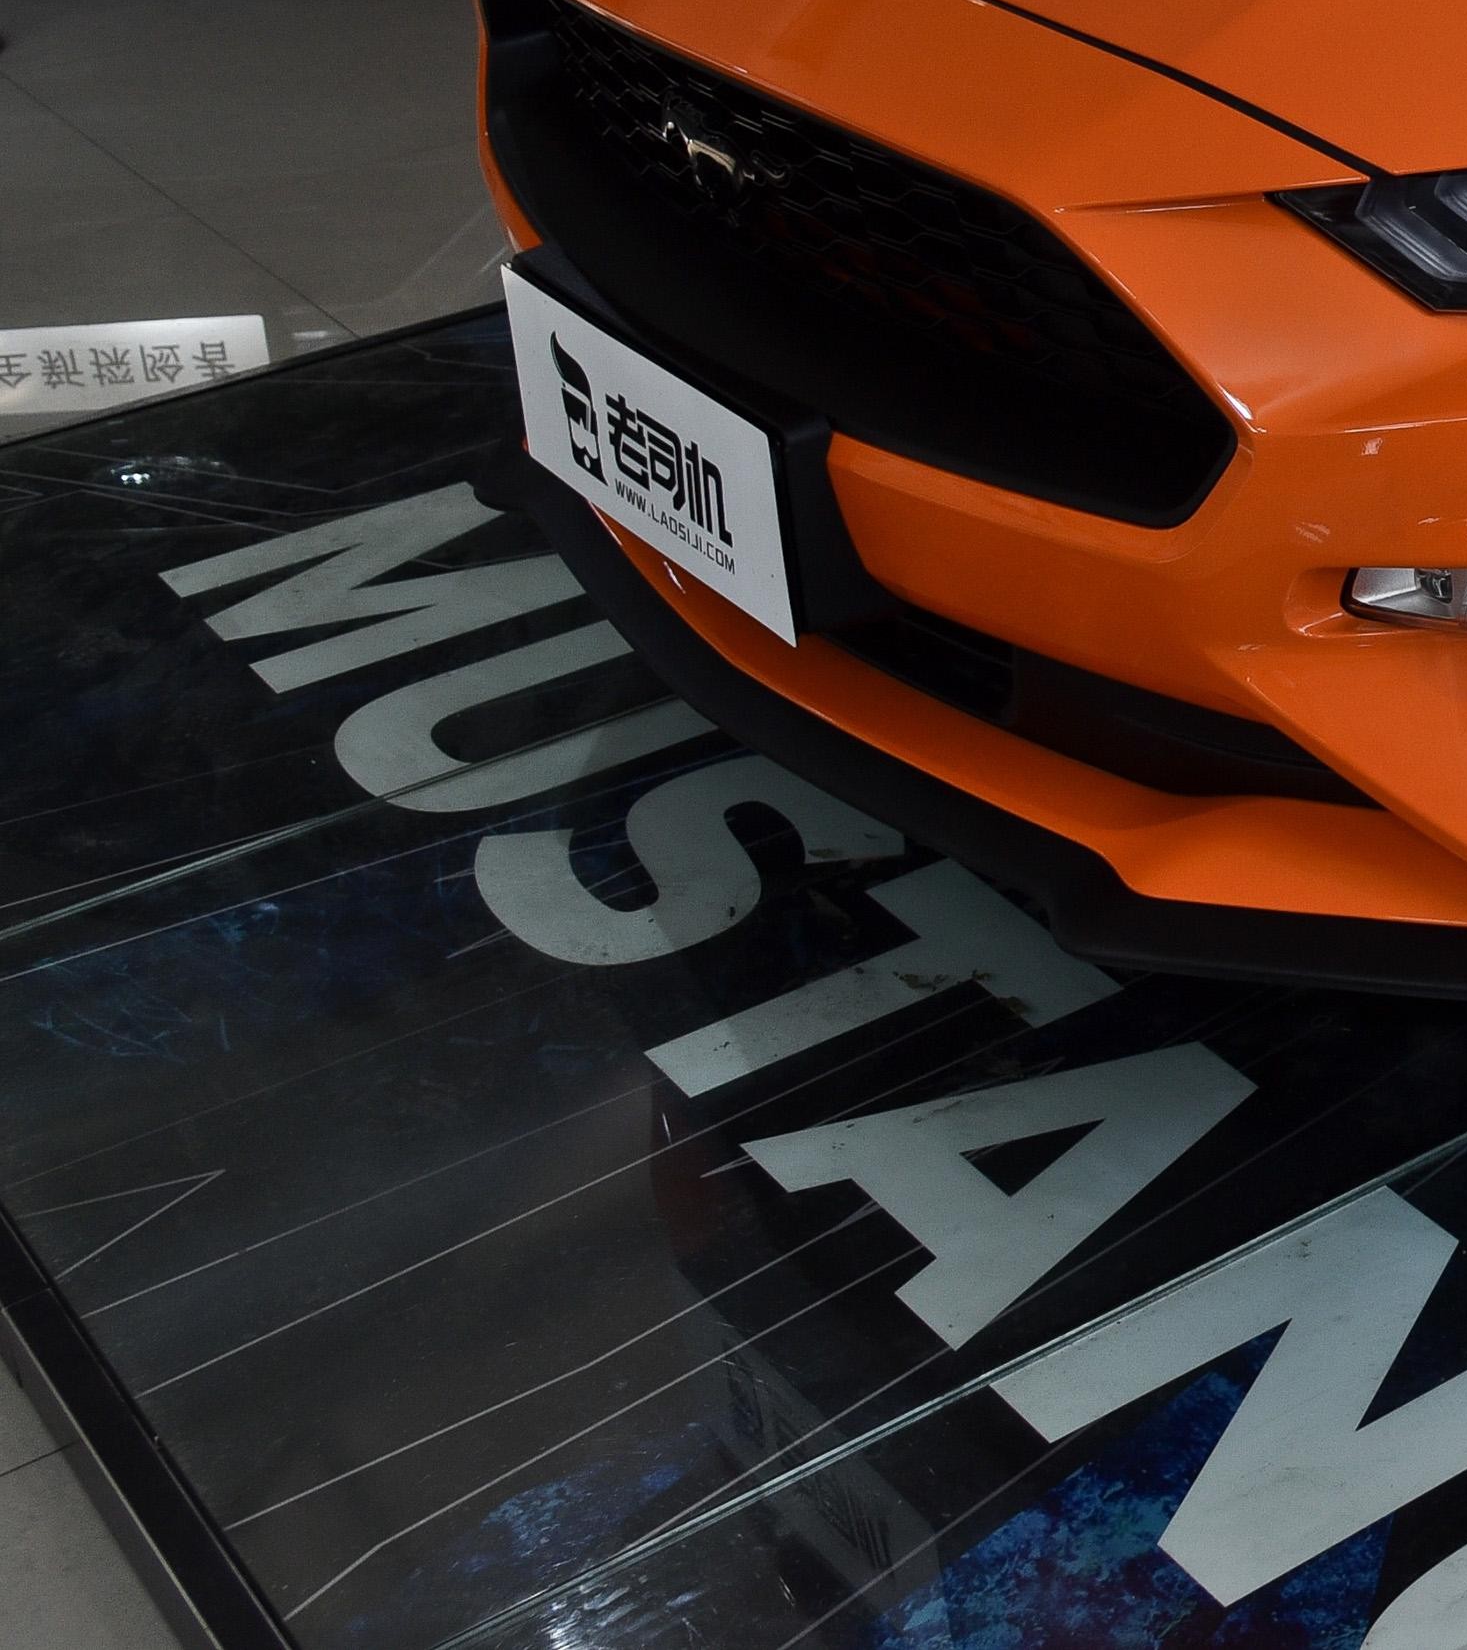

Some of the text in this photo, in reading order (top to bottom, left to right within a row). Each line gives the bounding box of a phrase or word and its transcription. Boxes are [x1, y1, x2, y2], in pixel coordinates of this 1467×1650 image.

[605, 392, 734, 549] 老司机
[615, 477, 735, 575] WWW.LAOSIJI.COM
